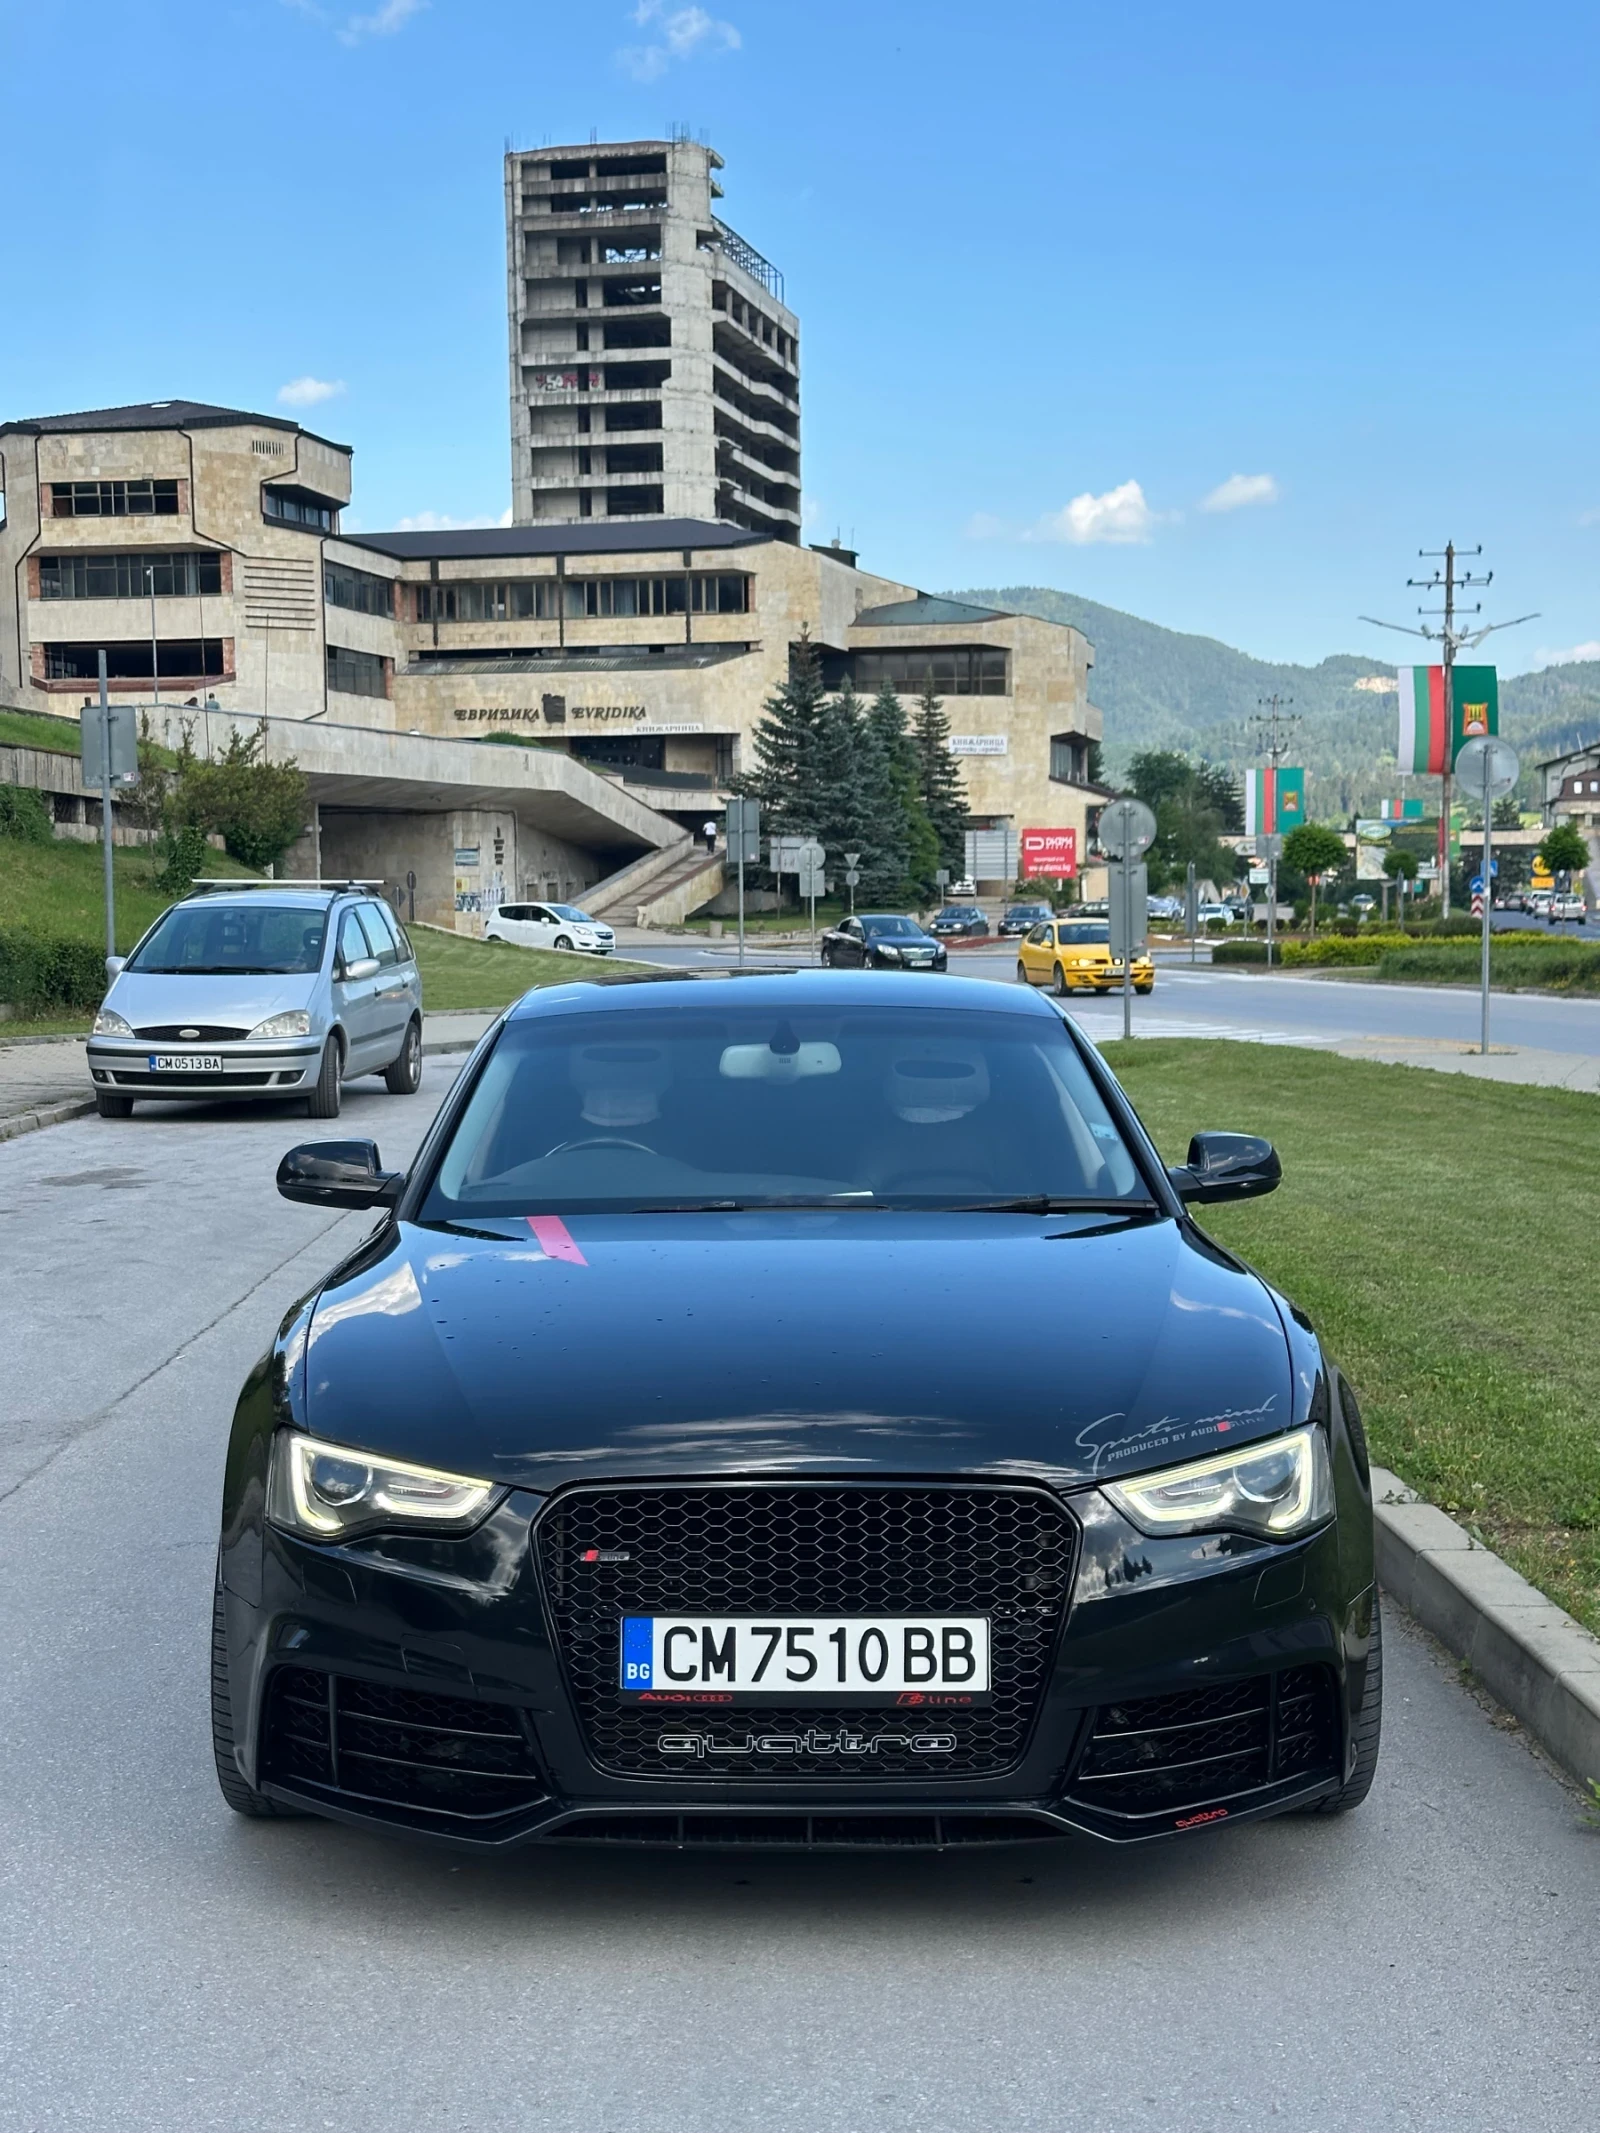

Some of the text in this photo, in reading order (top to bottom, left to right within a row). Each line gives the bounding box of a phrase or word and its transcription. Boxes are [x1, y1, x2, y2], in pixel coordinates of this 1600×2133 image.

[453, 708, 540, 723] ЕВРИДИКА
[571, 706, 647, 721] EVRIDIKA
[174, 1057, 202, 1069] 0513
[1075, 1412, 1190, 1476] Sports
[1107, 1436, 1169, 1463] PRODUCED
[1172, 1431, 1187, 1442] BY
[1190, 1426, 1217, 1438] AUDI
[663, 1626, 976, 1682] CM 7510 BB
[627, 1663, 650, 1679] BG
[658, 1729, 957, 1758] quattro
[1175, 1809, 1228, 1828] quattro
